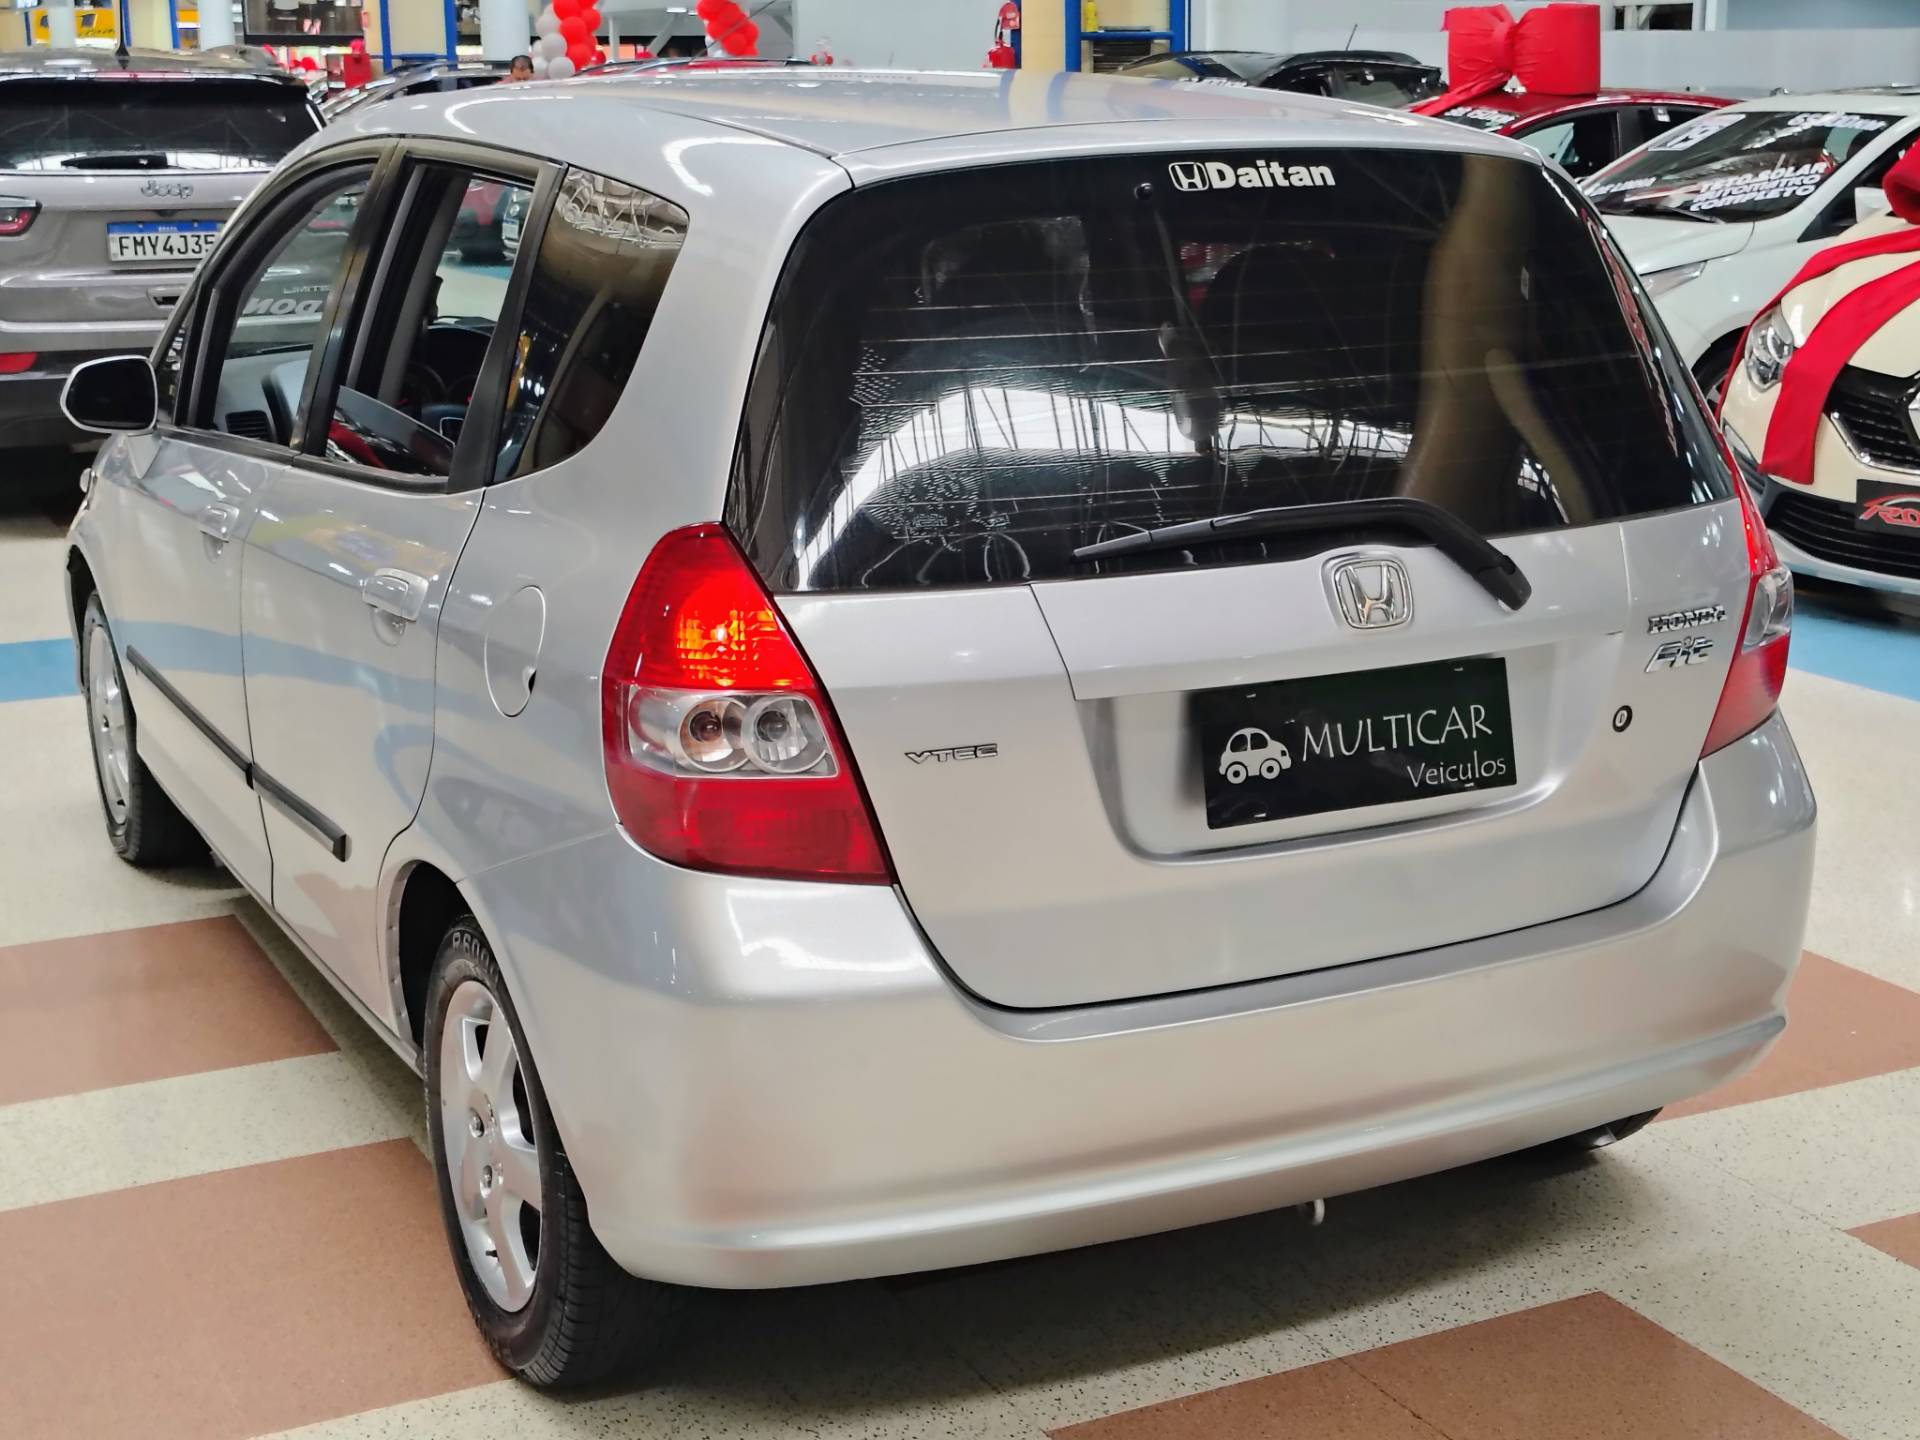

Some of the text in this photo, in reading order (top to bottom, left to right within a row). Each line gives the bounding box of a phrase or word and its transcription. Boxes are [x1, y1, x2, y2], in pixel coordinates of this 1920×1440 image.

[1205, 160, 1336, 189] Daitan
[141, 180, 193, 199] Jeep
[283, 285, 330, 295] LIMITE
[1646, 604, 1728, 635] HONDA
[1302, 703, 1493, 763] MULTICAR
[904, 742, 998, 765] VTEC
[1406, 750, 1507, 788] Veiculos
